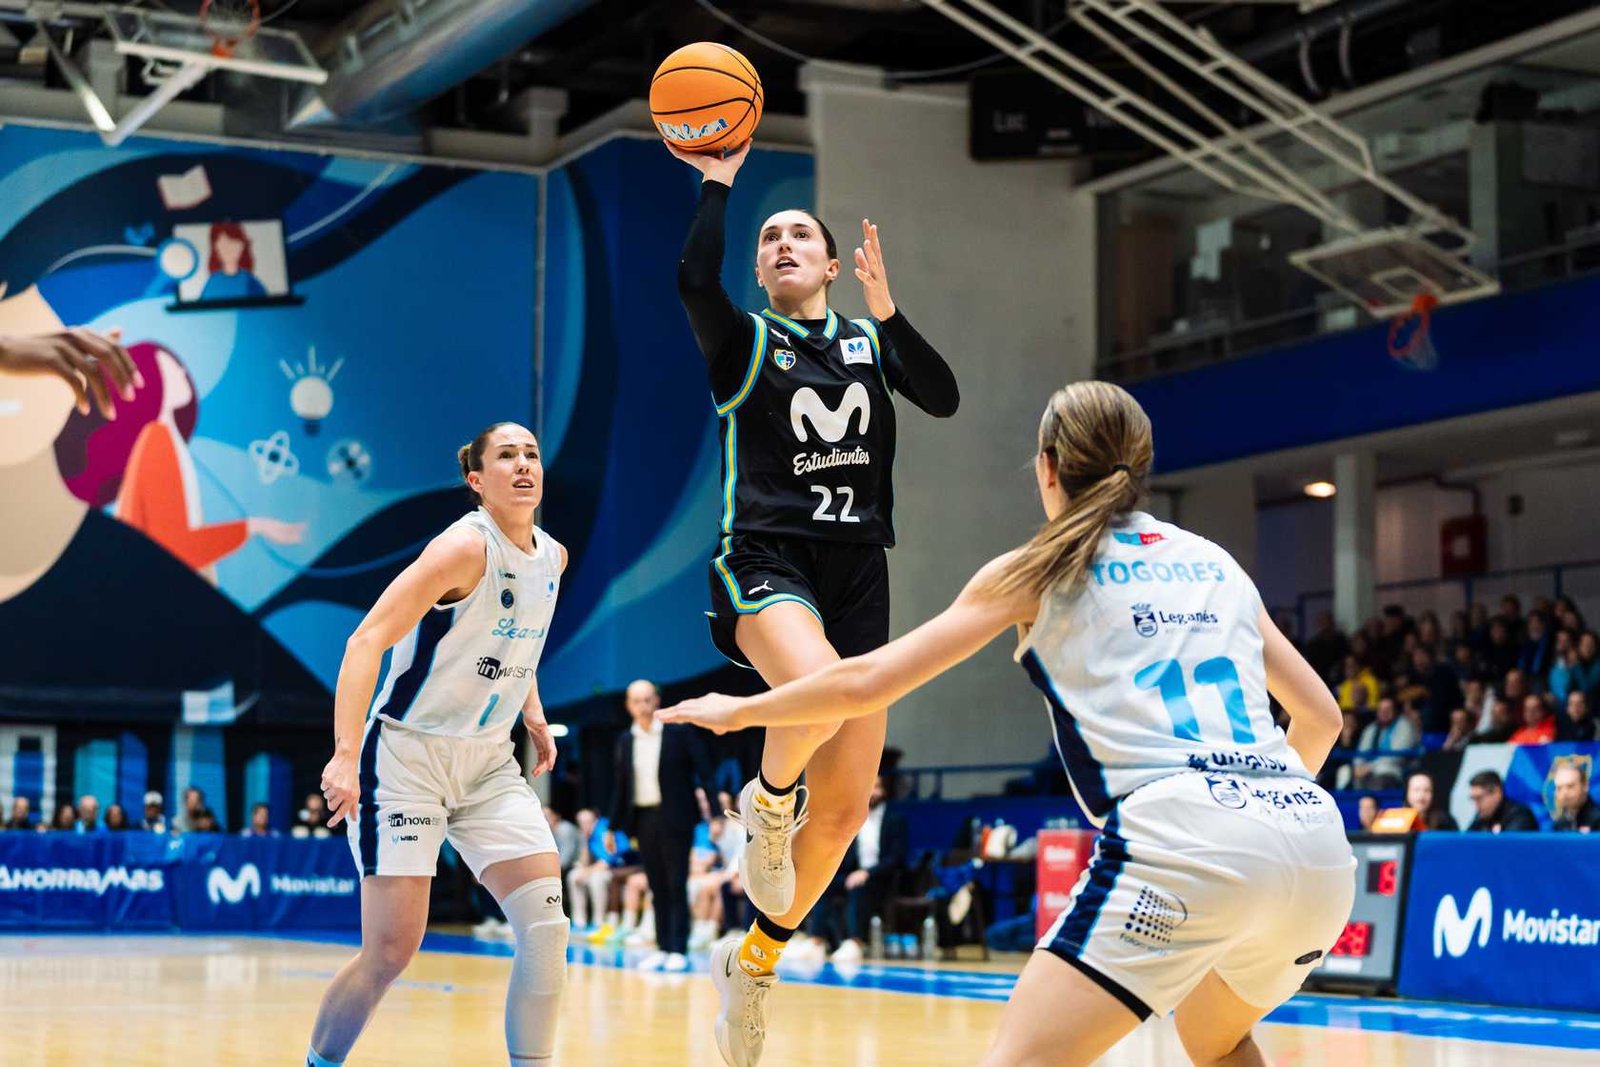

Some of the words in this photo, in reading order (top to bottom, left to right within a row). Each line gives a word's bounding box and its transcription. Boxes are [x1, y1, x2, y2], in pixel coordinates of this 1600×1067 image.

[792, 445, 870, 476] Estudiantes
[810, 485, 861, 523] 22
[1090, 560, 1226, 586] TOGORES
[479, 693, 500, 726] 1
[1134, 656, 1257, 745] 11
[271, 875, 355, 896] Movistar
[1502, 908, 1600, 945] Movistar
